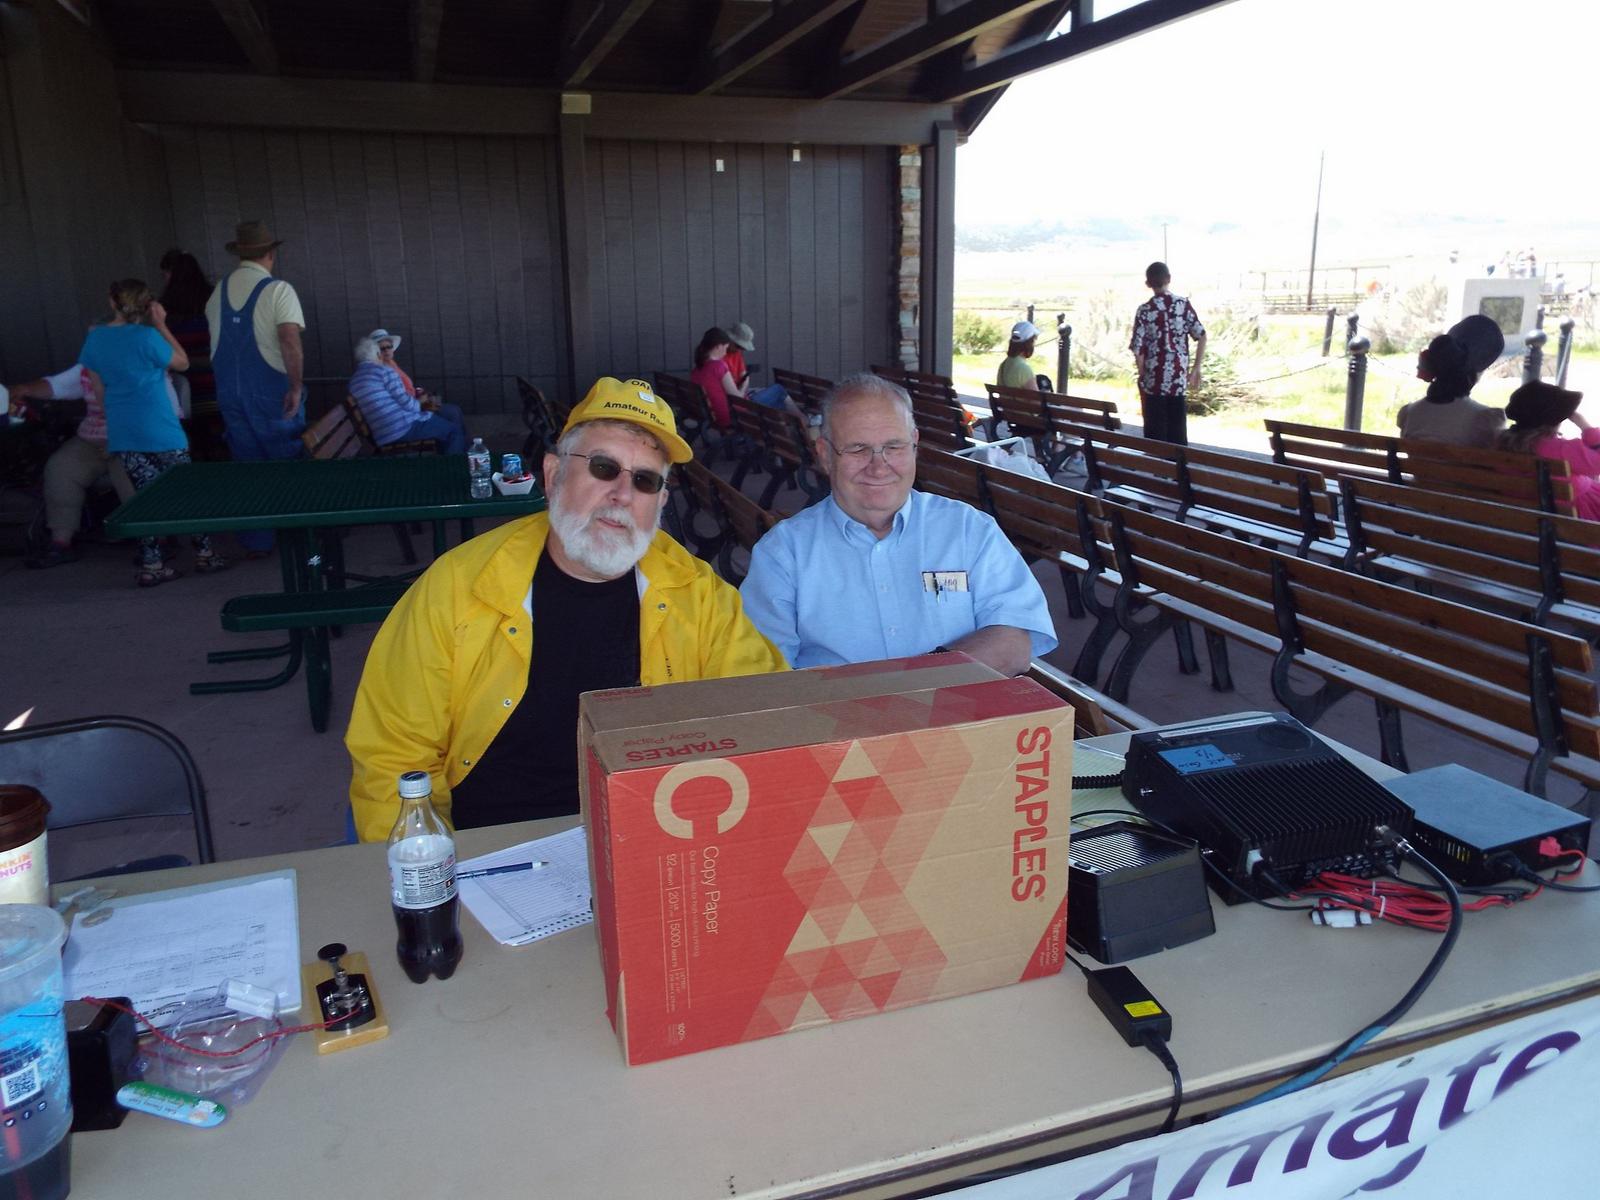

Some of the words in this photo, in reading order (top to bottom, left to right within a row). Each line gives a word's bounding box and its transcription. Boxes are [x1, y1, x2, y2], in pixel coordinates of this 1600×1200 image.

[604, 401, 649, 416] Amateur
[669, 731, 706, 742] Copy
[626, 739, 737, 762] STAPLES
[1011, 726, 1052, 902] STAPLES
[0, 860, 33, 878] NUTS
[666, 853, 677, 866] 92
[701, 846, 719, 886] Copy
[668, 890, 680, 904] 20
[702, 891, 720, 934] Paper
[670, 923, 681, 948] 5000
[1051, 942, 1059, 964] LOOK
